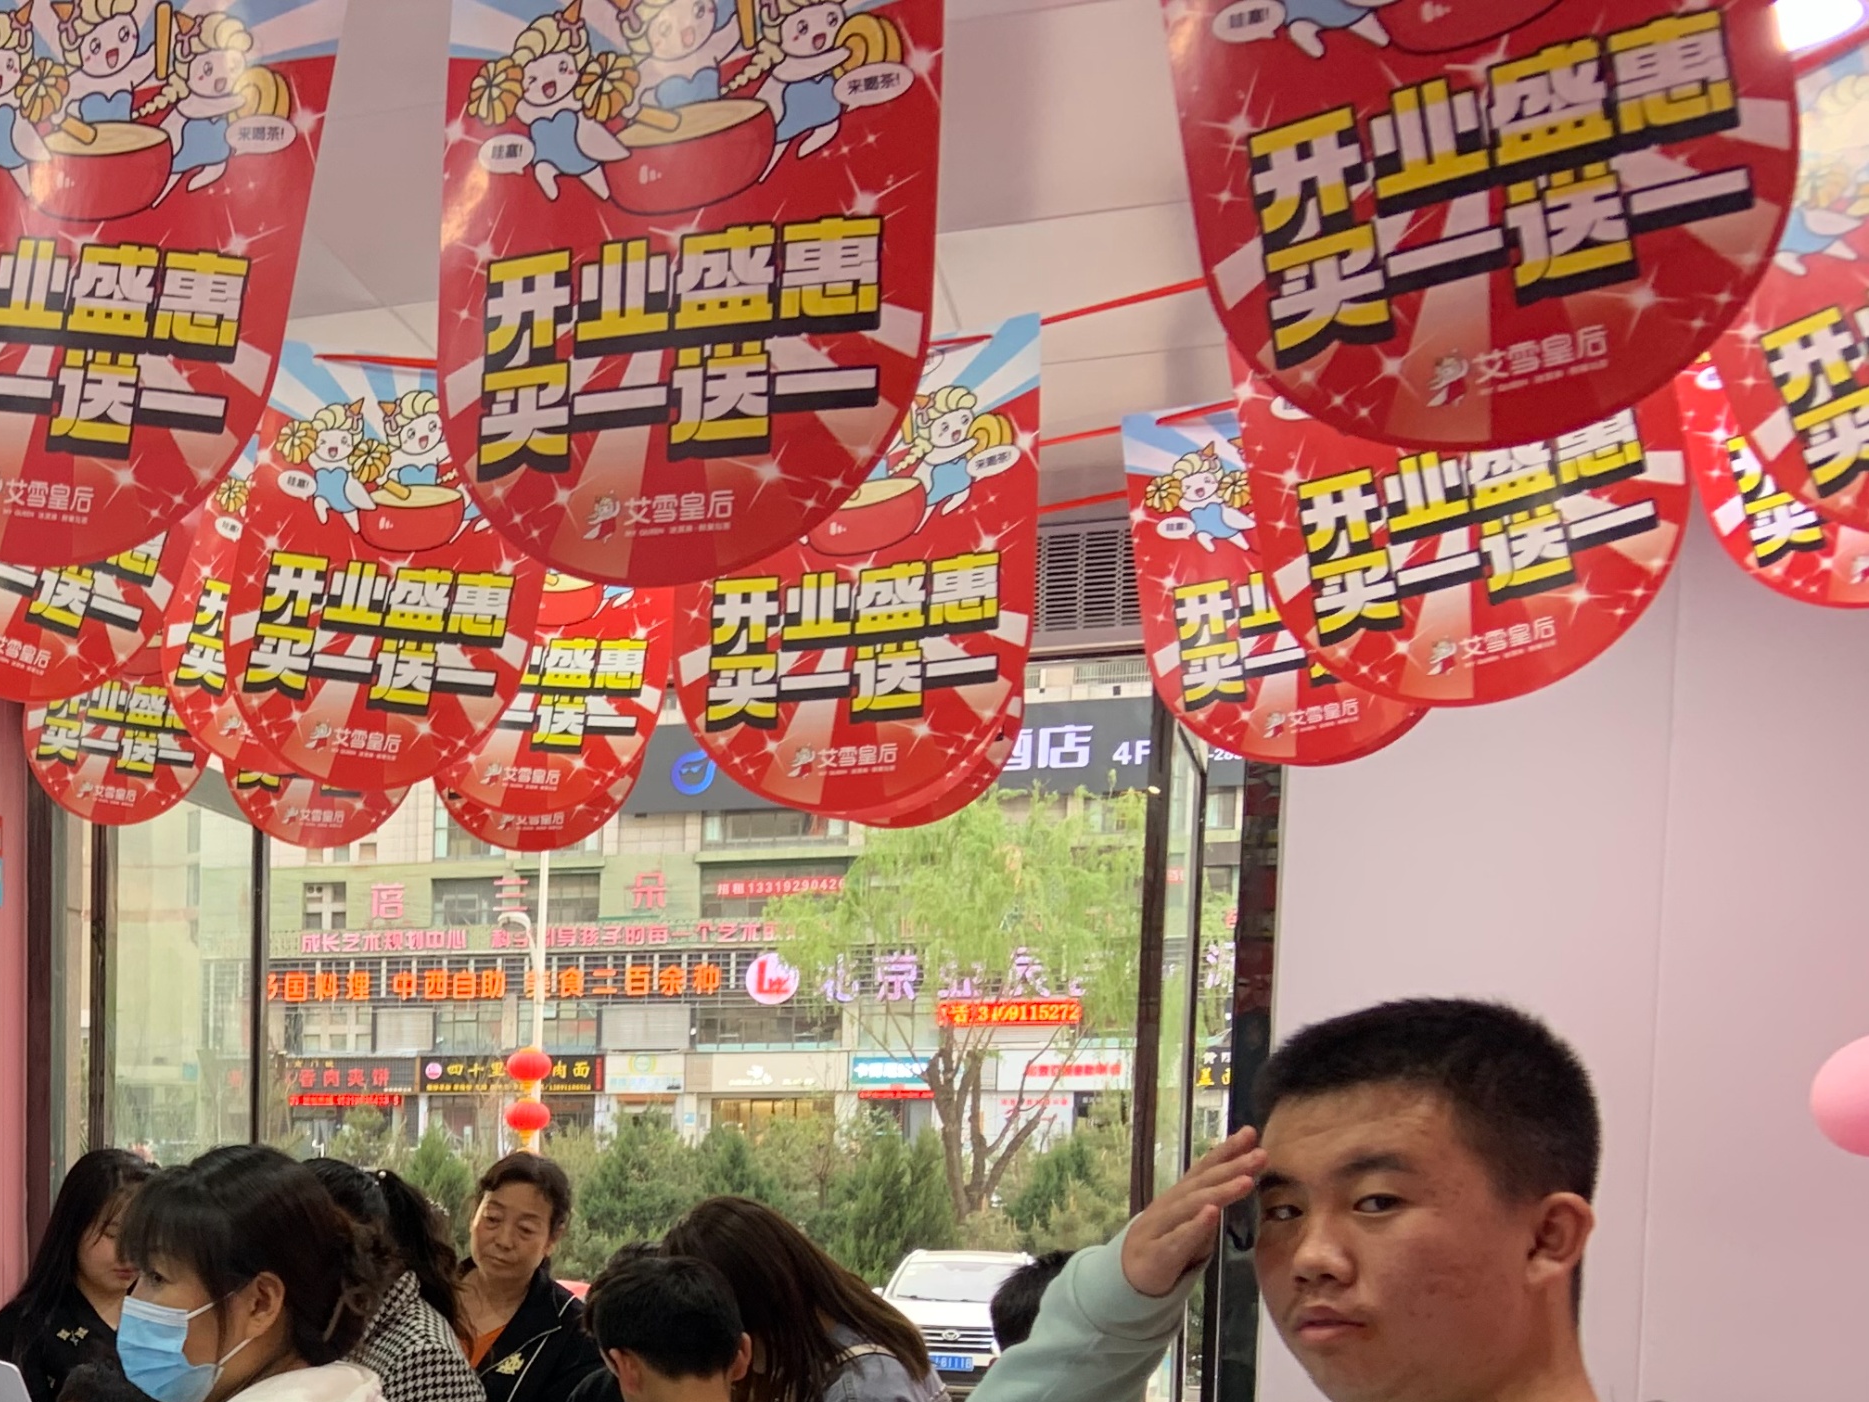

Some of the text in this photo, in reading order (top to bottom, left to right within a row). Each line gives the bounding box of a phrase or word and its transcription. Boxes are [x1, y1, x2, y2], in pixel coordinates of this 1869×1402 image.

[847, 71, 902, 98] 来喝茶!
[237, 124, 286, 143] 来喝茶!
[1248, 9, 1741, 248] 开业盛惠
[1264, 163, 1755, 370] 买一送一
[483, 214, 886, 369] 开业盛惠
[1472, 324, 1608, 386] 艾雪皇后
[477, 337, 882, 486] 买一送一
[3, 479, 95, 514] 艾雪皇后
[1297, 405, 1650, 556] 开业盛惠
[623, 490, 736, 526] 艾雪皇后
[1308, 498, 1660, 648] 买一送一
[265, 550, 516, 648] 开业盛惠
[708, 550, 1001, 653] 开业盛惠
[1461, 616, 1557, 659] 艾雪皇后
[243, 620, 498, 716] 买一送一
[705, 640, 1000, 732] 买一送一
[1290, 698, 1360, 728] 艾雪皇后
[36, 716, 196, 779] 买一送一
[332, 725, 403, 756] 艾雪皇后
[817, 742, 899, 771] 艾雪皇后
[1112, 739, 1151, 766] 4F
[94, 783, 138, 805] 艾雪皇后
[501, 765, 560, 787] 艾雪皇后
[297, 806, 347, 827] 艾雪皇后
[301, 929, 467, 954] 成长艺术规划中心
[393, 967, 507, 1001] 中西自助
[447, 1059, 591, 1080] 四十里肉面
